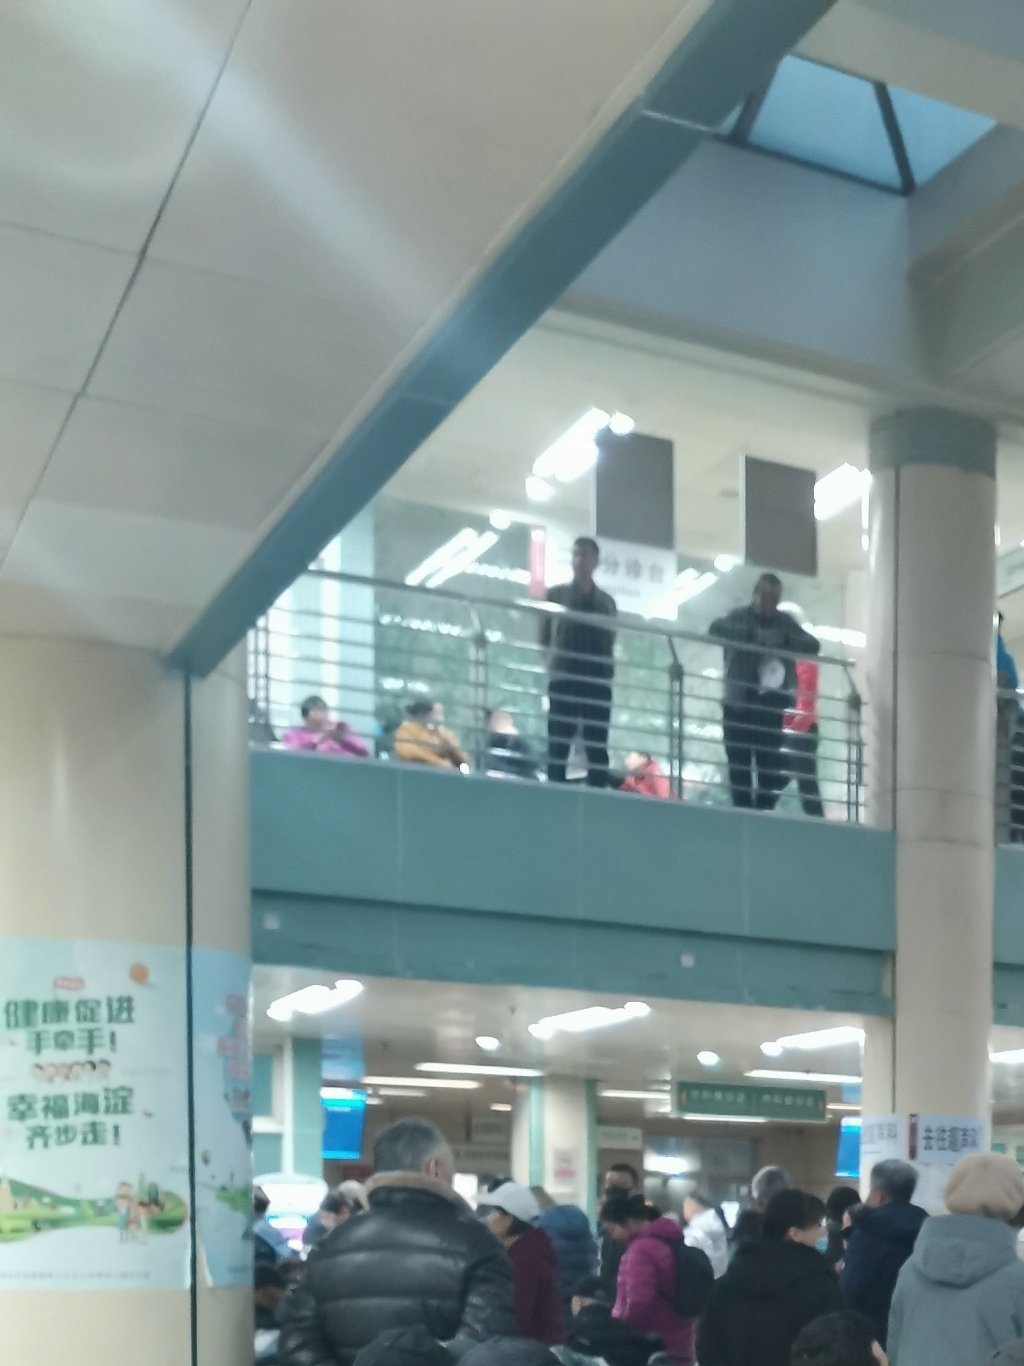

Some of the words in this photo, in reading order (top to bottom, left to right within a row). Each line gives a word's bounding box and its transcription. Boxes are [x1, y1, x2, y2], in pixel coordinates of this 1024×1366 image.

[5, 995, 135, 1028] 健康促进
[8, 1086, 134, 1121] 幸福海淀
